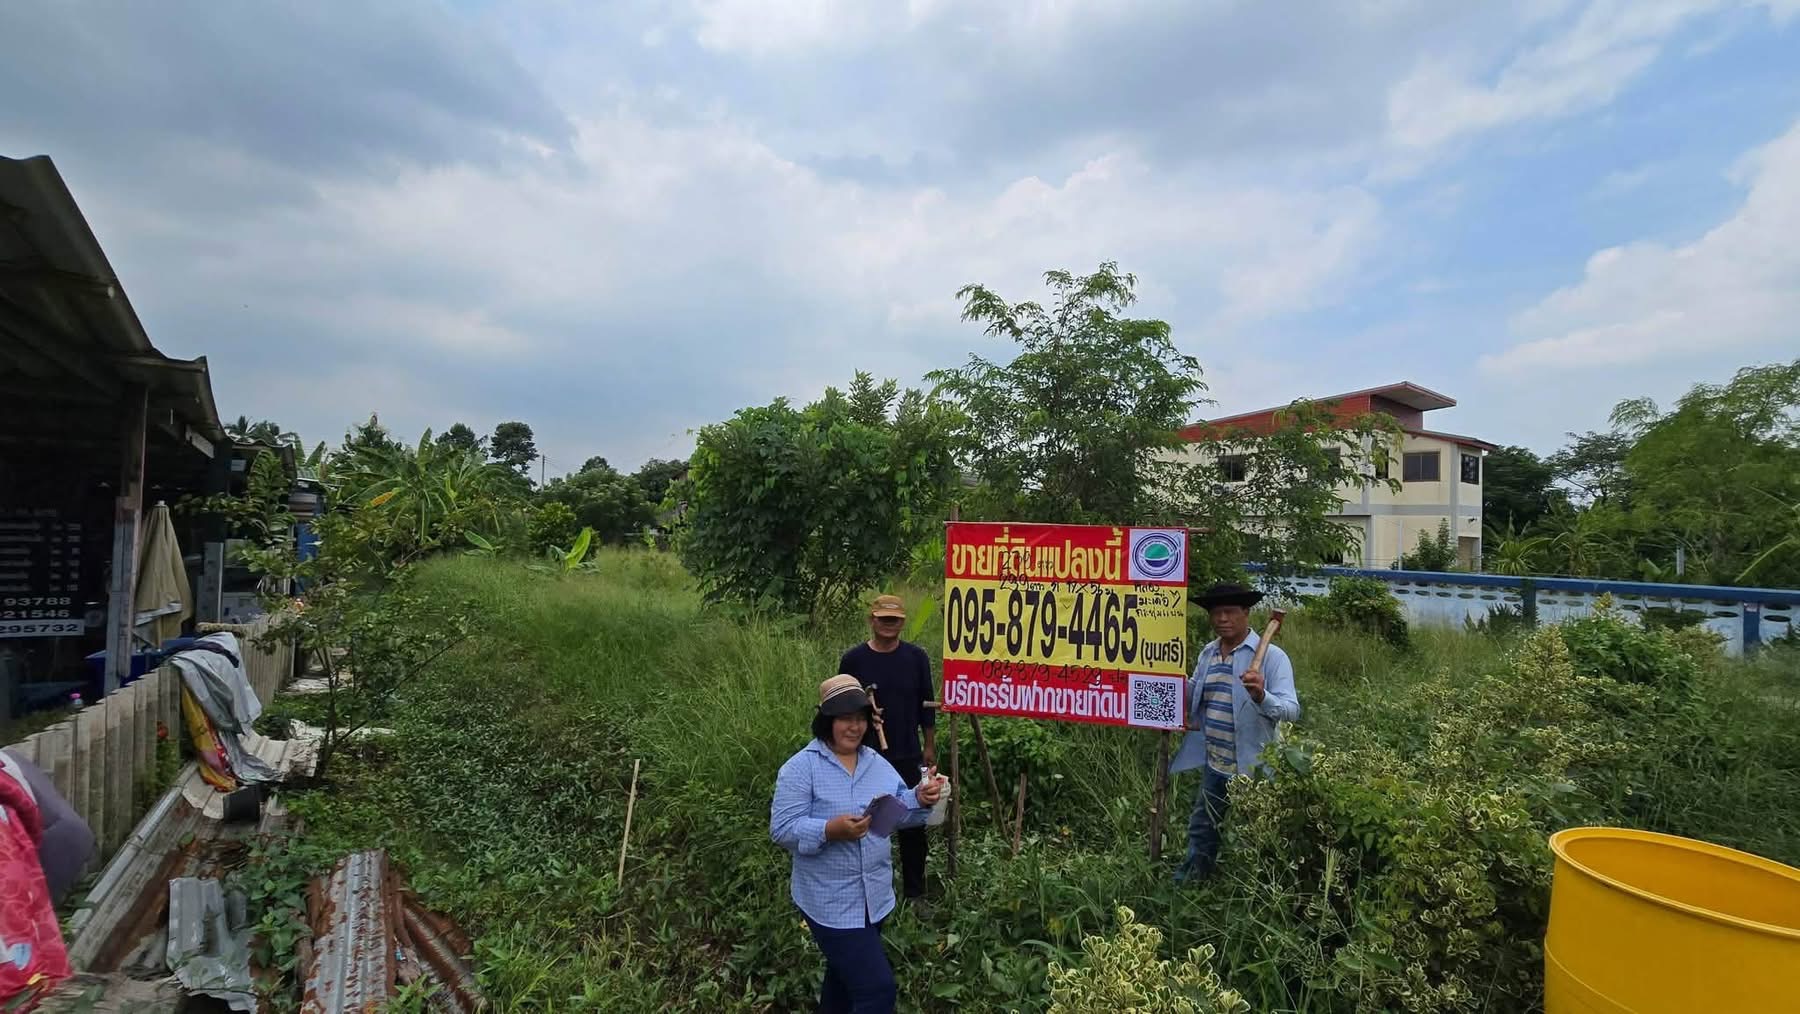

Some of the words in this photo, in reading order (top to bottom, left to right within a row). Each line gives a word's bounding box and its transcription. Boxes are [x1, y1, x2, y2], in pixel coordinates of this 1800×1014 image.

[952, 526, 1123, 580] ขายที่ดินแปลงนี้
[0, 597, 72, 607] 93788
[0, 609, 71, 619] 21546
[948, 586, 1138, 664] 095-879-4465
[1141, 636, 1184, 668] (ขุนศรี)
[945, 672, 1126, 720] บริการรับฝากขายที่ดิน
